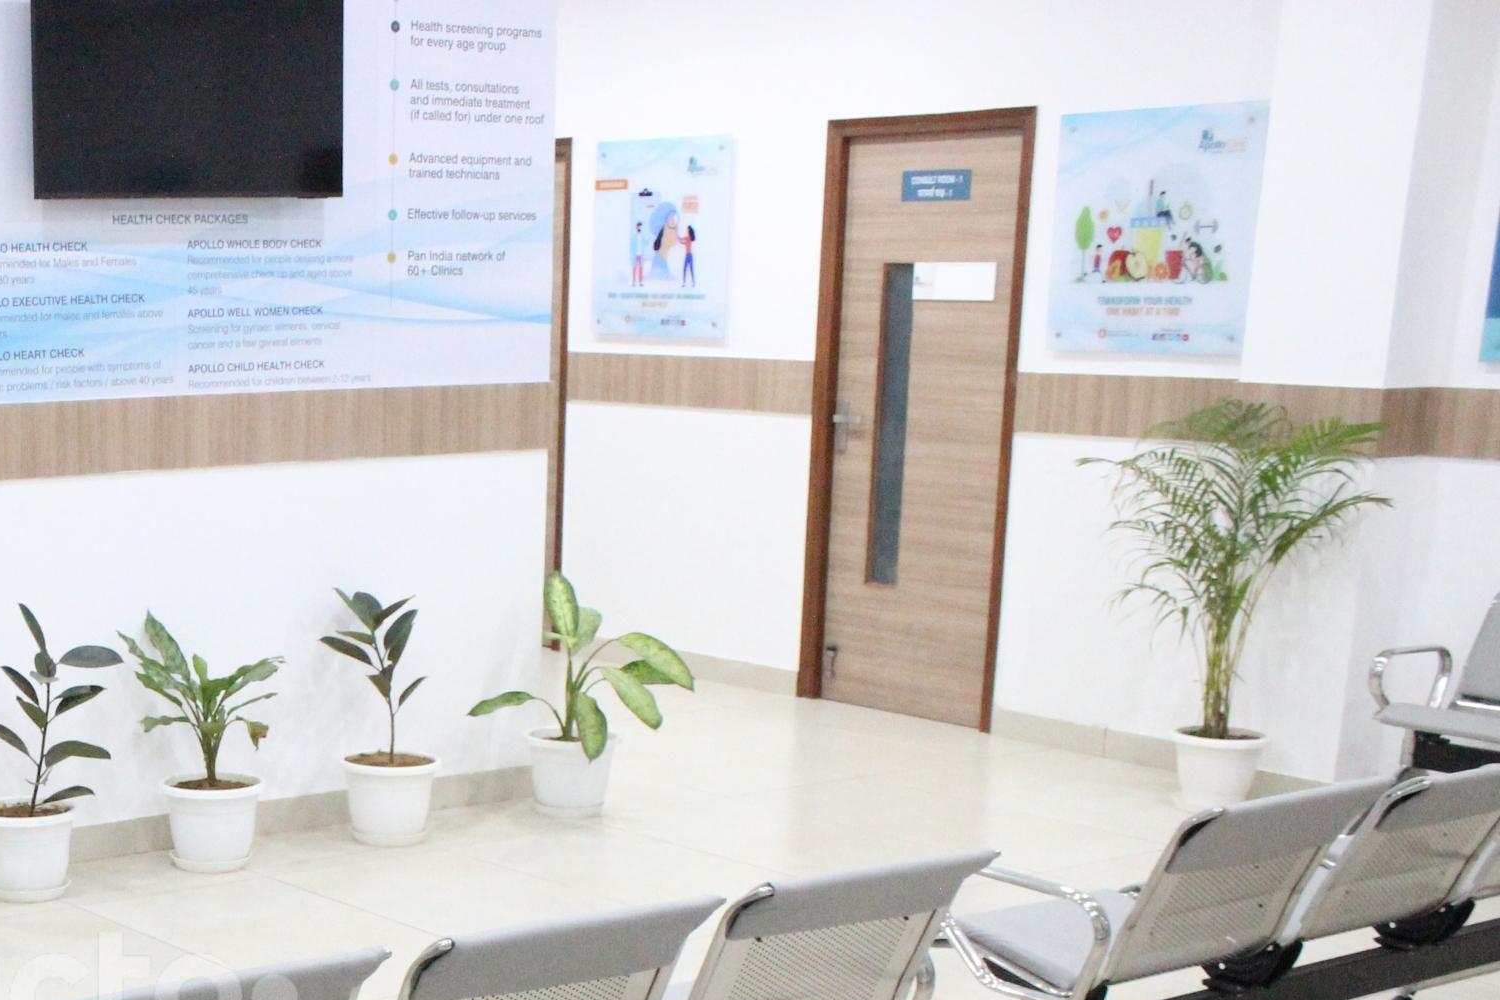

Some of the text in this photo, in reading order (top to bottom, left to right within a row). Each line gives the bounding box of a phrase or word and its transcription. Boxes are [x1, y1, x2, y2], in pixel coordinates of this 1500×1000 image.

[410, 20, 542, 40] Health screening programs
[410, 35, 506, 53] for every age group
[410, 79, 519, 94] All tests, consultations
[410, 95, 530, 109] and immediate treatment
[410, 109, 545, 125] (if called for) under one roof
[409, 152, 531, 167] Advanced equipment and
[409, 168, 500, 180] trained technicians
[112, 214, 248, 225] HEALTH CHECK PACKAGES
[407, 208, 537, 222] Effective follow-up services
[11, 242, 49, 252] HEALTH
[52, 241, 88, 251] CHECK
[187, 239, 322, 249] APOLLO WHOLE BODY CHECK
[407, 250, 506, 261] Pan India network of
[430, 264, 464, 276] Clinics
[12, 296, 67, 307] EXECUTIVE
[70, 294, 108, 305] HEALTH
[111, 293, 145, 304] CHECK
[188, 306, 323, 318] APOLLO WELL WOMEN CHECK
[14, 350, 46, 360] HEART
[50, 348, 84, 359] CHECK
[188, 360, 324, 373] APOLLO CHILD HEALTH CHECK
